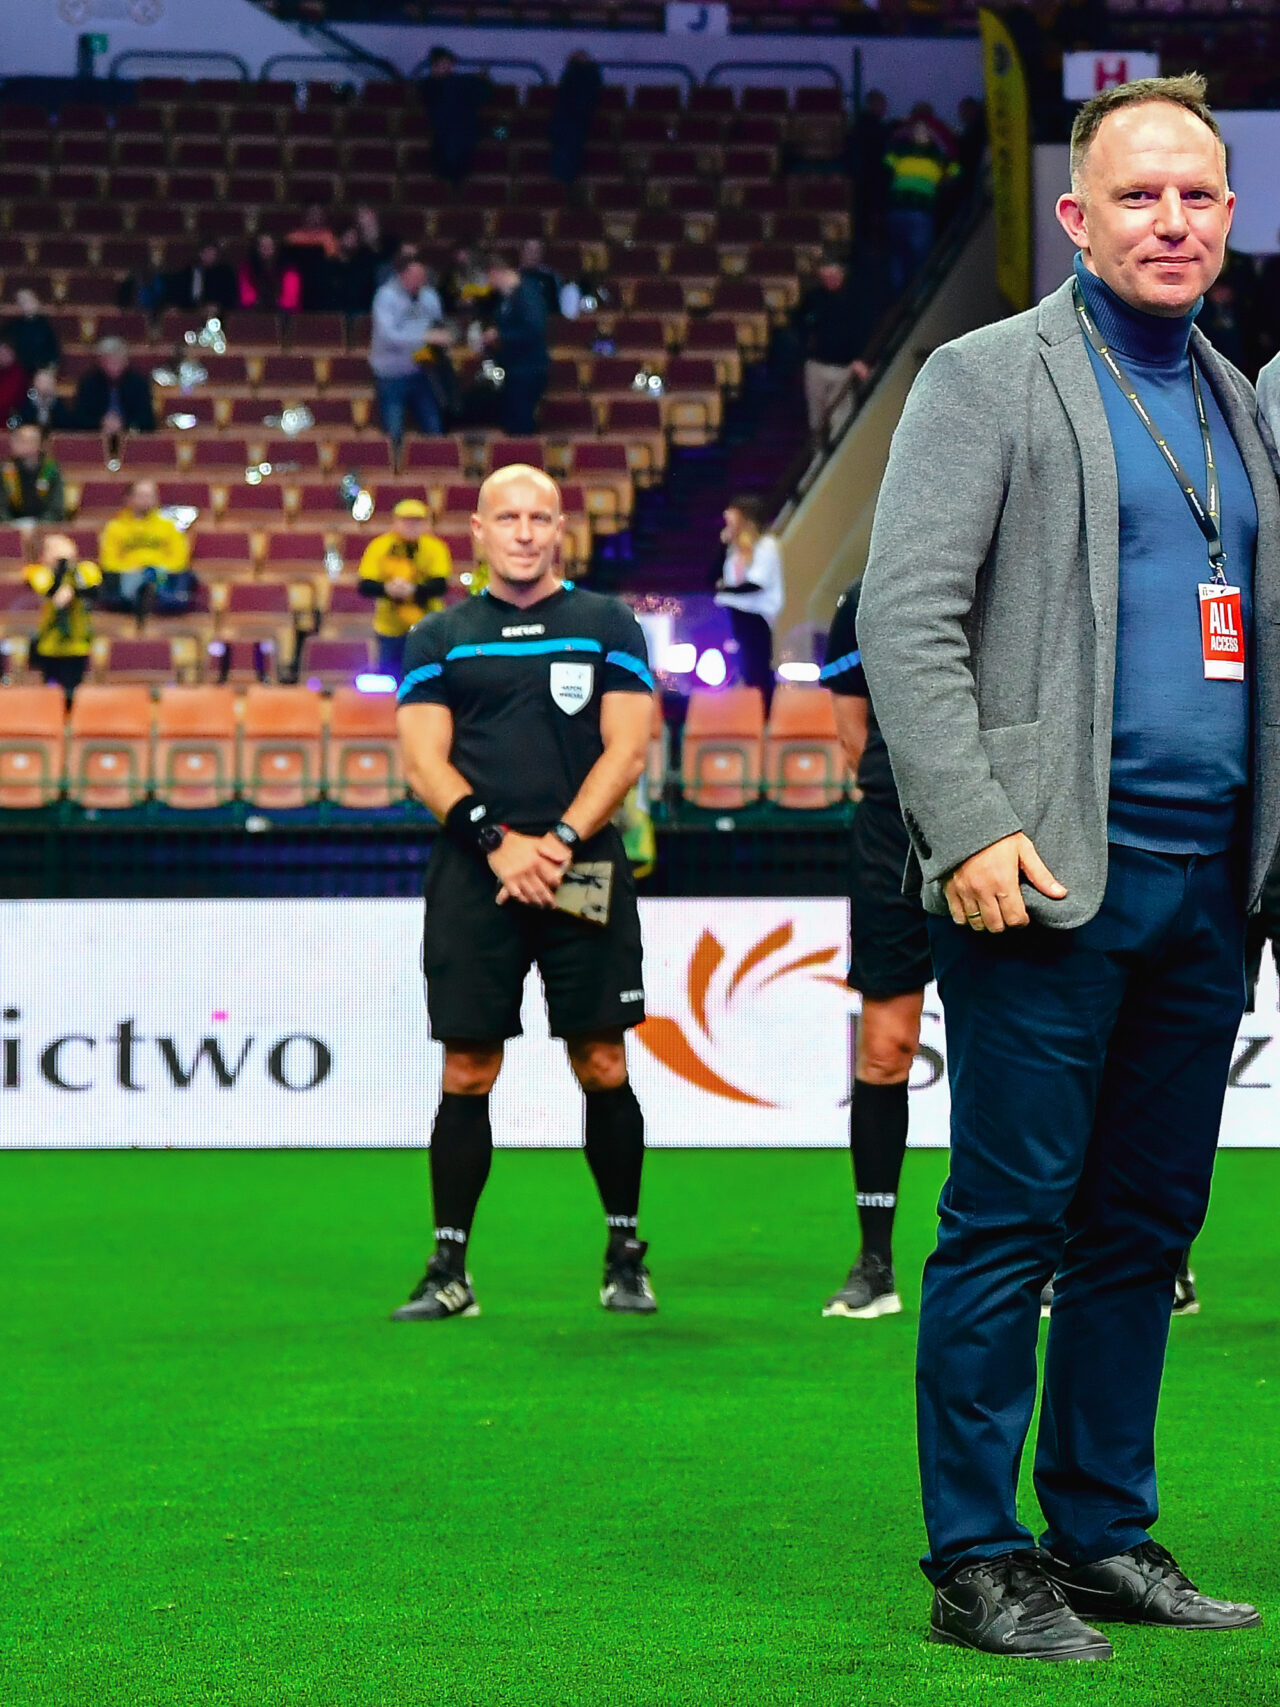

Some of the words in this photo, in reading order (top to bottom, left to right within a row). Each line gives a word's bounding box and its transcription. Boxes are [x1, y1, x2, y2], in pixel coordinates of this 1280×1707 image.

[686, 7, 708, 32] J
[1093, 56, 1128, 92] H
[1209, 601, 1238, 636] ALL
[1210, 635, 1239, 653] ACCESS
